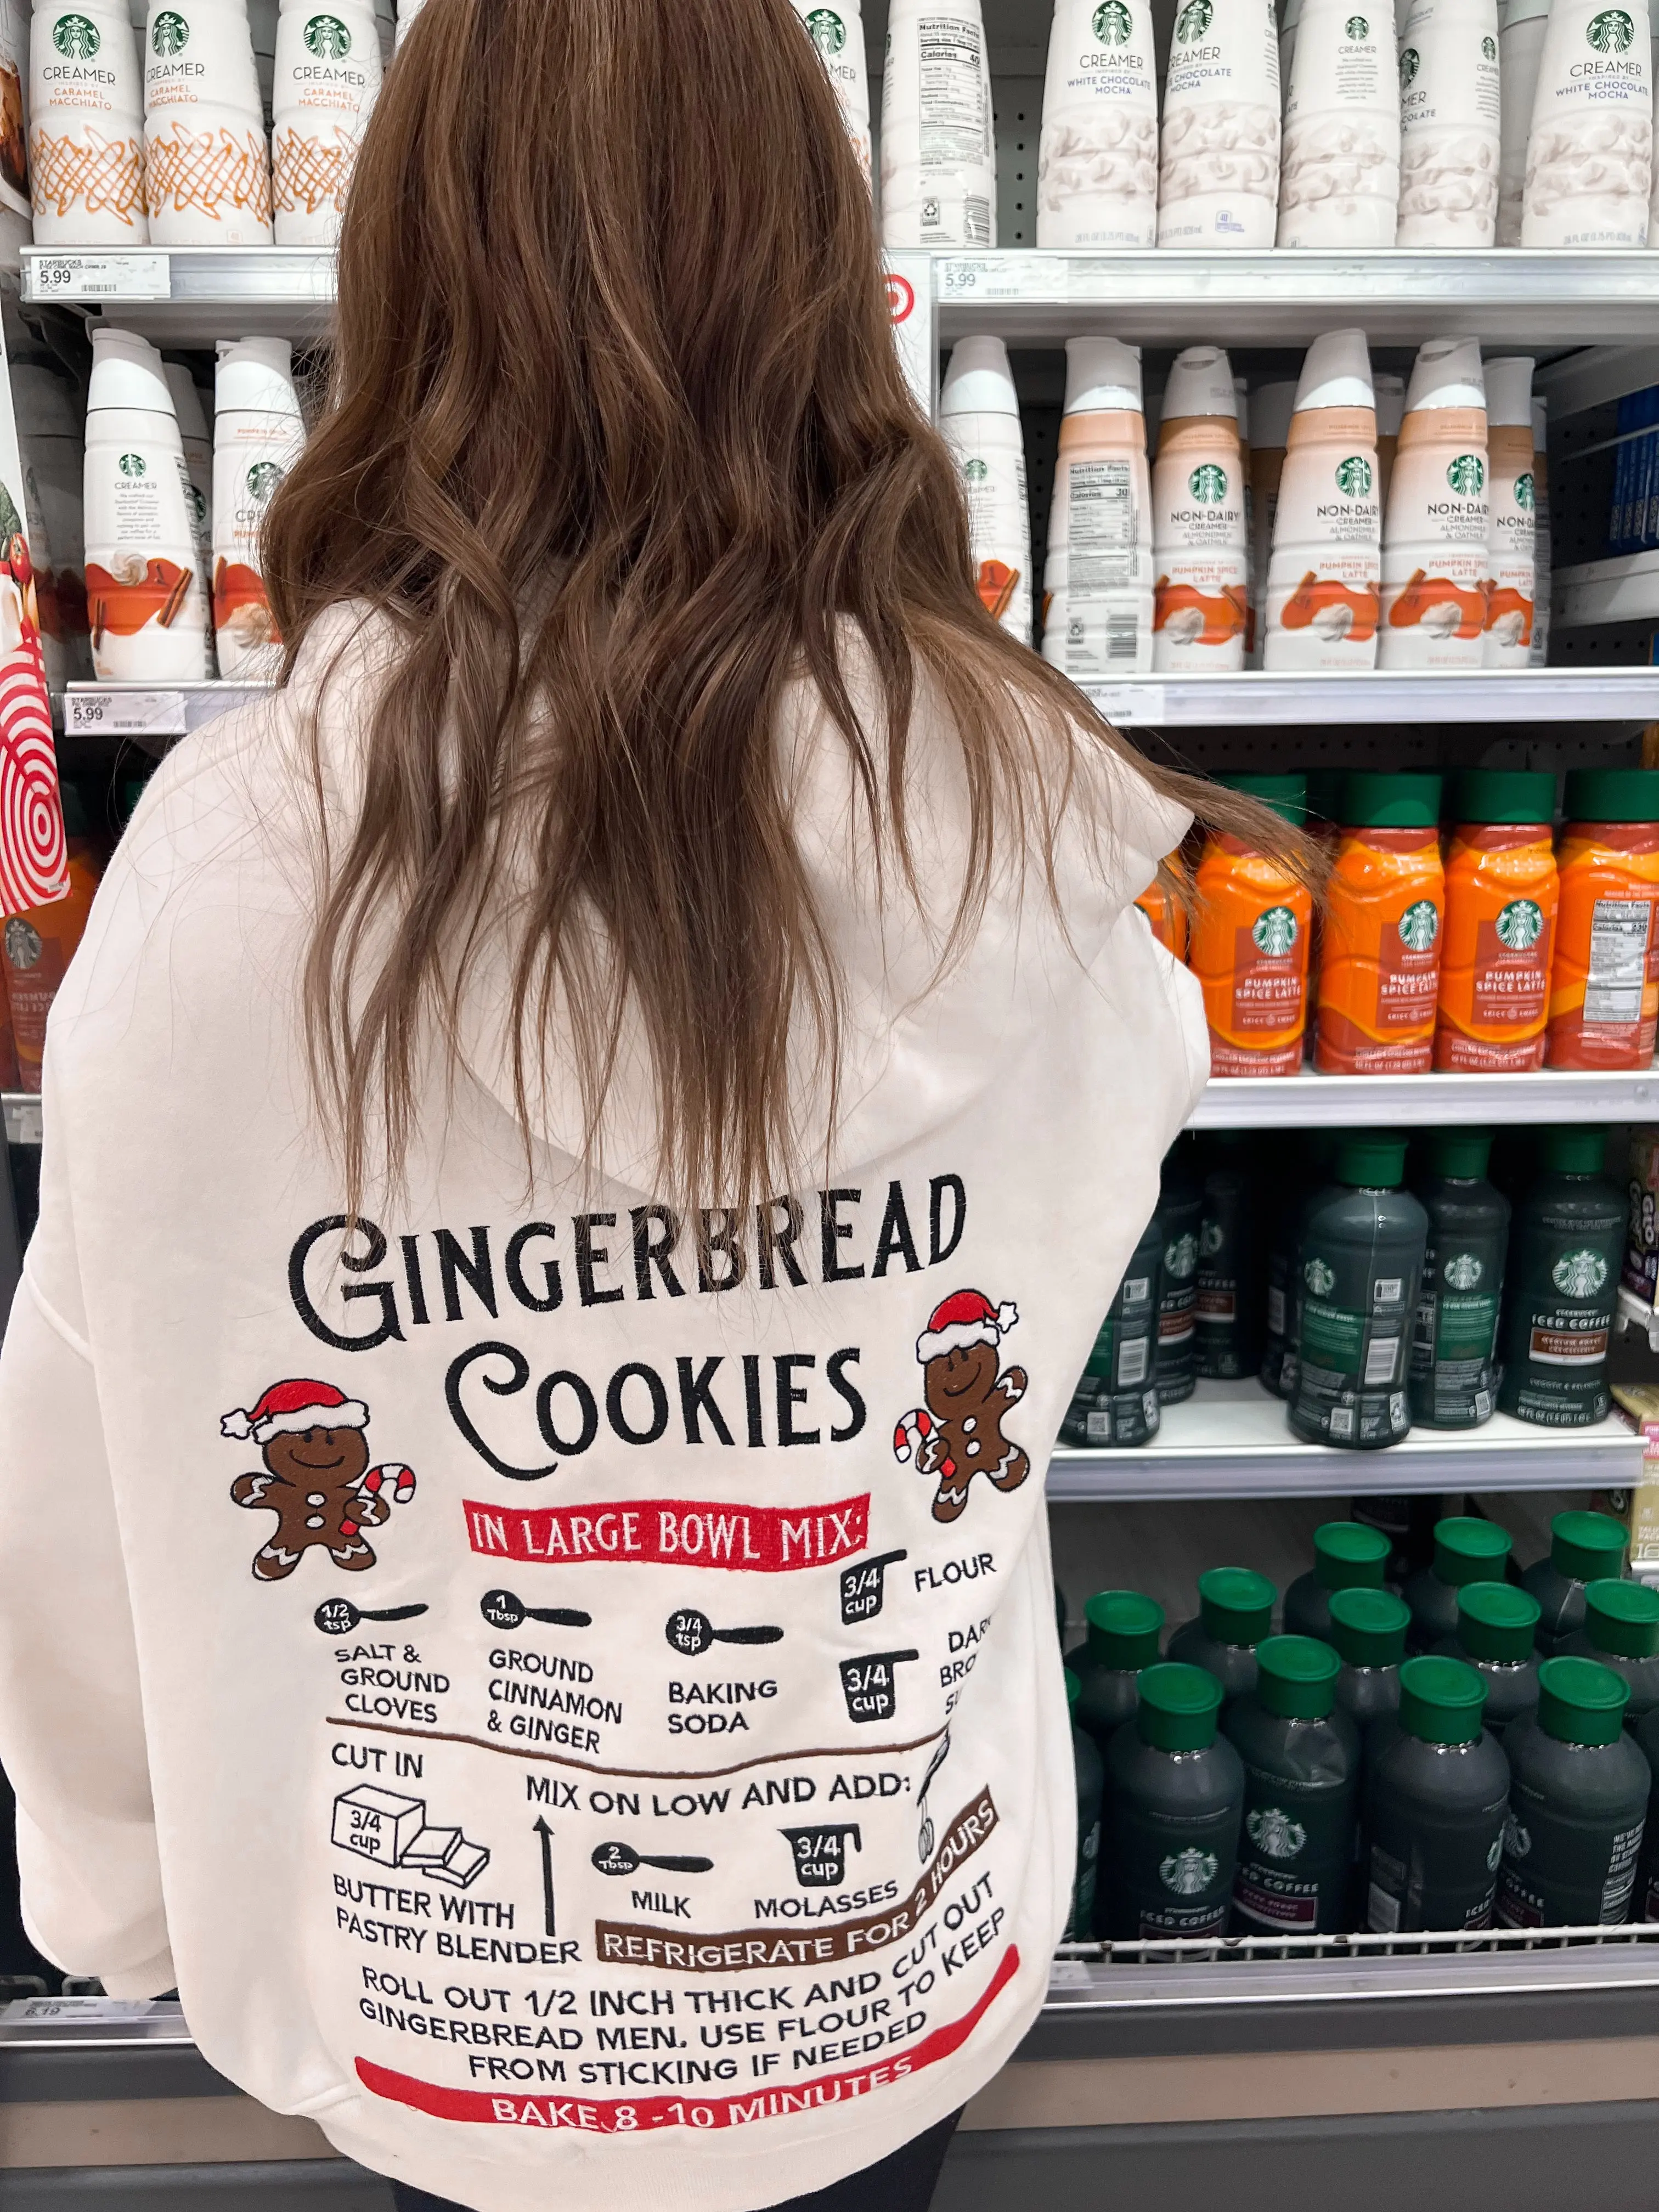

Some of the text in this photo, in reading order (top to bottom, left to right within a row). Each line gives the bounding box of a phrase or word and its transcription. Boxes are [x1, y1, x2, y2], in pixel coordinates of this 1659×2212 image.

[919, 23, 960, 32] Nutrition
[921, 50, 957, 59] Calories
[1338, 46, 1377, 54] CREAMER
[1080, 54, 1144, 70] CREAMER
[1570, 60, 1641, 77] CREAMER
[43, 66, 115, 86] CREAMER
[146, 63, 205, 83] CREAMER
[293, 66, 365, 88] CREAMER
[1174, 68, 1232, 83] CHOCOLATE
[150, 84, 191, 98] CARAMEL
[1067, 76, 1097, 87] WHITE
[1100, 75, 1151, 91] CHOCOLATE
[1095, 86, 1132, 95] MOCHA
[1556, 81, 1649, 97] WHITE CHOCOLATE
[54, 88, 105, 100] CARAMEL
[148, 94, 199, 108] MACCHIATO
[303, 88, 354, 101] CARAMEL
[1588, 91, 1628, 99] MOCHA
[49, 98, 112, 110] MACCHIATO
[298, 98, 360, 113] MACCHIATO
[1402, 109, 1436, 123] COLATE
[40, 270, 71, 284] 5.99
[945, 274, 976, 287] 5.99
[1171, 510, 1240, 522] NON-DAIRY
[1447, 515, 1483, 523] CREAMER
[1496, 516, 1536, 529] NON-DA
[1188, 522, 1228, 531] CREAMER
[1172, 566, 1214, 575] PUMPKIN
[1319, 561, 1362, 570] PUMPKIN
[1429, 559, 1472, 569] PUMPKIN
[1193, 574, 1222, 583] LATTE
[1452, 568, 1478, 577] LATTE
[74, 707, 103, 720] 5.99
[1245, 976, 1299, 989] PUMPKIN
[1390, 970, 1437, 985] PUMPKIN
[1486, 970, 1542, 983] PUMPKIN
[1235, 985, 1302, 1000] SPICE LATTE
[1381, 983, 1416, 996] SPICE
[1476, 978, 1545, 993] SPICE LATTE
[287, 1173, 967, 1352] GINGERBREAD
[1569, 1314, 1611, 1330] COFFEE
[444, 1339, 867, 1481] COOKIES
[471, 1512, 509, 1551] IN
[521, 1511, 642, 1557] LARGE
[659, 1511, 760, 1560] BOWL
[914, 1553, 997, 1593] FLOUR
[844, 1568, 879, 1598] 3/4
[496, 1595, 505, 1609] 1
[845, 1594, 878, 1615] cup
[321, 1603, 349, 1618] 1/2
[487, 1609, 518, 1624] Tbsp
[324, 1619, 352, 1631] tsp
[676, 1615, 702, 1632] 3/4
[676, 1632, 702, 1649] tsp
[335, 1644, 421, 1663] SALT &
[488, 1649, 594, 1683] GROUND
[940, 1653, 977, 1688] BRO
[341, 1668, 450, 1694] GROUND
[846, 1664, 889, 1693] 3/4
[668, 1680, 778, 1704] BAKING
[345, 1693, 438, 1723] CLOVES
[488, 1679, 622, 1724] CINNAMON
[852, 1693, 890, 1717] cup
[668, 1711, 750, 1735] SODA
[487, 1709, 601, 1754] & GINGER
[332, 1742, 424, 1779] CUT IN
[527, 1773, 911, 1817] MIX ON LOW AND ADD:
[350, 1811, 381, 1833] 3/4
[349, 1833, 381, 1855] cup
[796, 1835, 843, 1860] 3/4
[608, 1846, 620, 1860] 2
[598, 1860, 634, 1871] Tbsp
[800, 1861, 839, 1883] cup
[602, 1799, 995, 1967] REFRIGERATE FOR 2 HOURS
[1263, 1877, 1319, 1893] COFFEE
[333, 1873, 515, 1931] BUTTER WITH
[631, 1890, 693, 1918] MILK
[754, 1880, 899, 1920] MOLASSES
[336, 1905, 583, 1965] PASTRY BLENDER
[362, 1870, 997, 2017] ROLL OUT 1/2 INCH THICK AND CUT OUT
[359, 1905, 1006, 2052] GINGERBREAD MEN. USE FLOUR TO KEEP
[469, 2009, 928, 2086] FROM STICKING IF NEEDED
[492, 2098, 598, 2131] BAKE
[614, 2105, 637, 2131] 8
[729, 2055, 913, 2126] MINUTES
